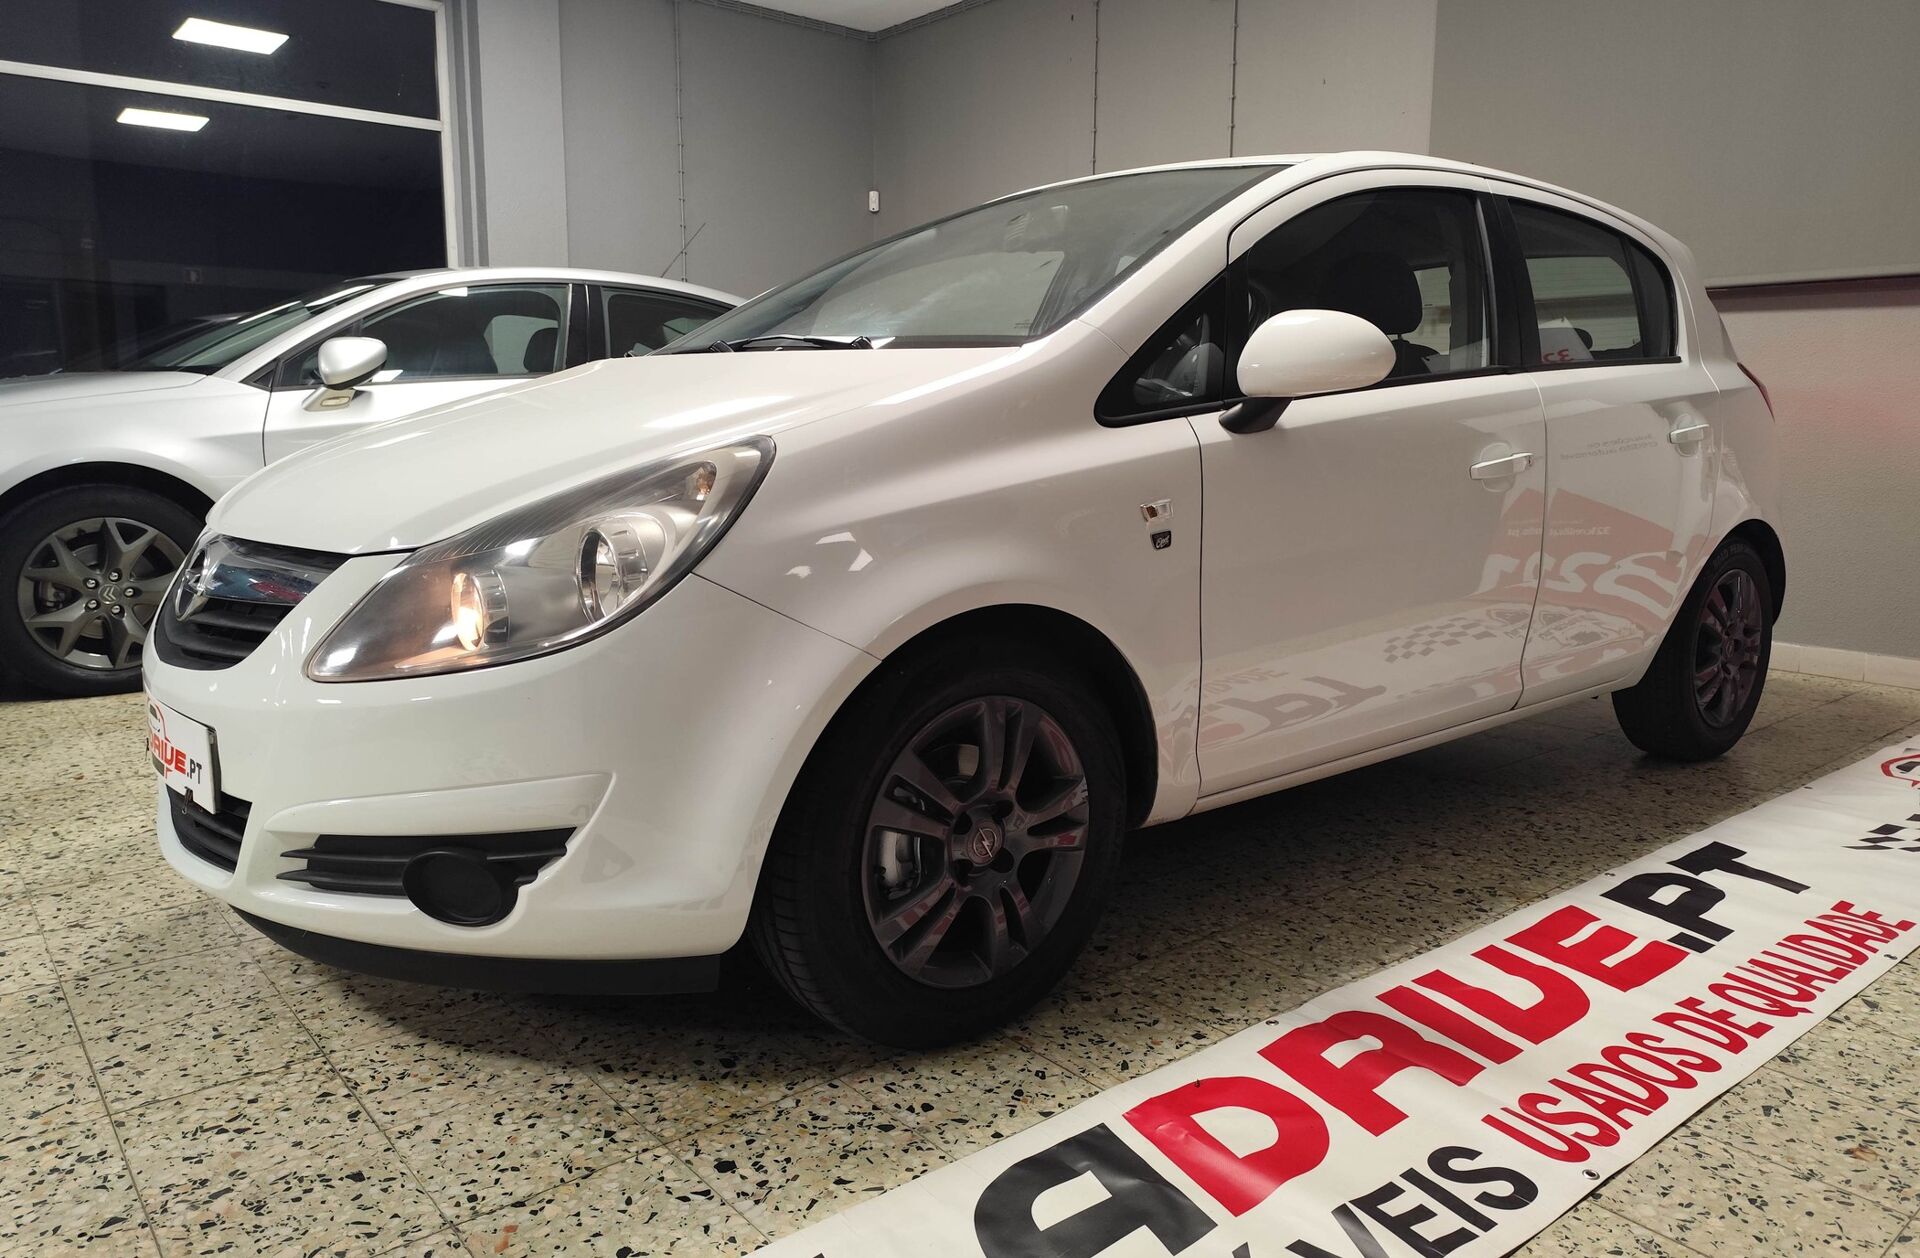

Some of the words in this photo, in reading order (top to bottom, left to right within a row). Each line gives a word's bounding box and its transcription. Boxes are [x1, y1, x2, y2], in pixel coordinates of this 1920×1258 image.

[150, 732, 202, 785] RIVE.PT
[1707, 900, 1917, 1016] QUALIDADE
[1658, 996, 1774, 1056] DE
[1482, 1032, 1722, 1163] USADOS
[1232, 1146, 1539, 1258] VEIS
